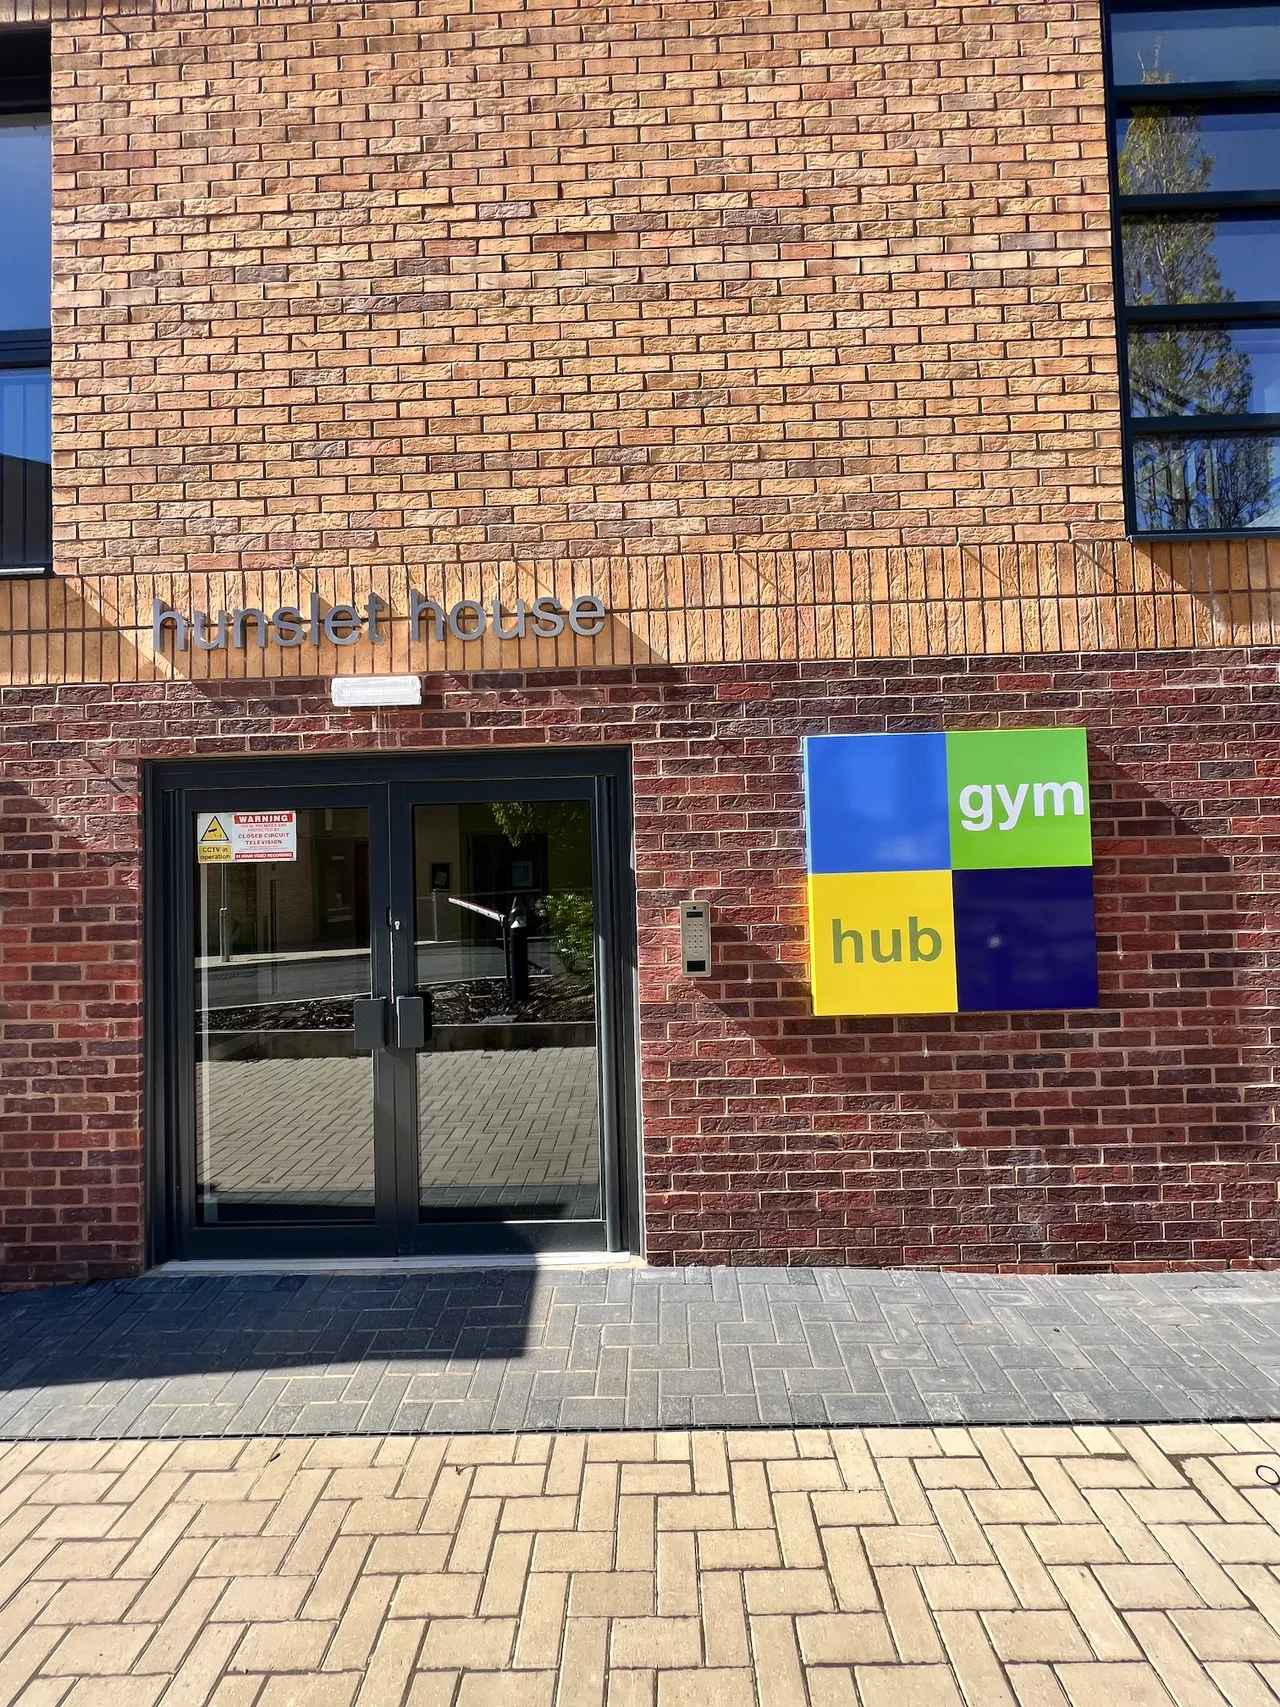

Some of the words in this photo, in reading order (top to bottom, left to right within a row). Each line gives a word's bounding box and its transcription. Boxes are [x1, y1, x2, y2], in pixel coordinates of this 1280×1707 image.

[152, 592, 385, 652] hunslet
[410, 588, 607, 644] house
[239, 815, 288, 823] WARNING
[959, 779, 1085, 832] gym
[831, 916, 943, 964] hub
